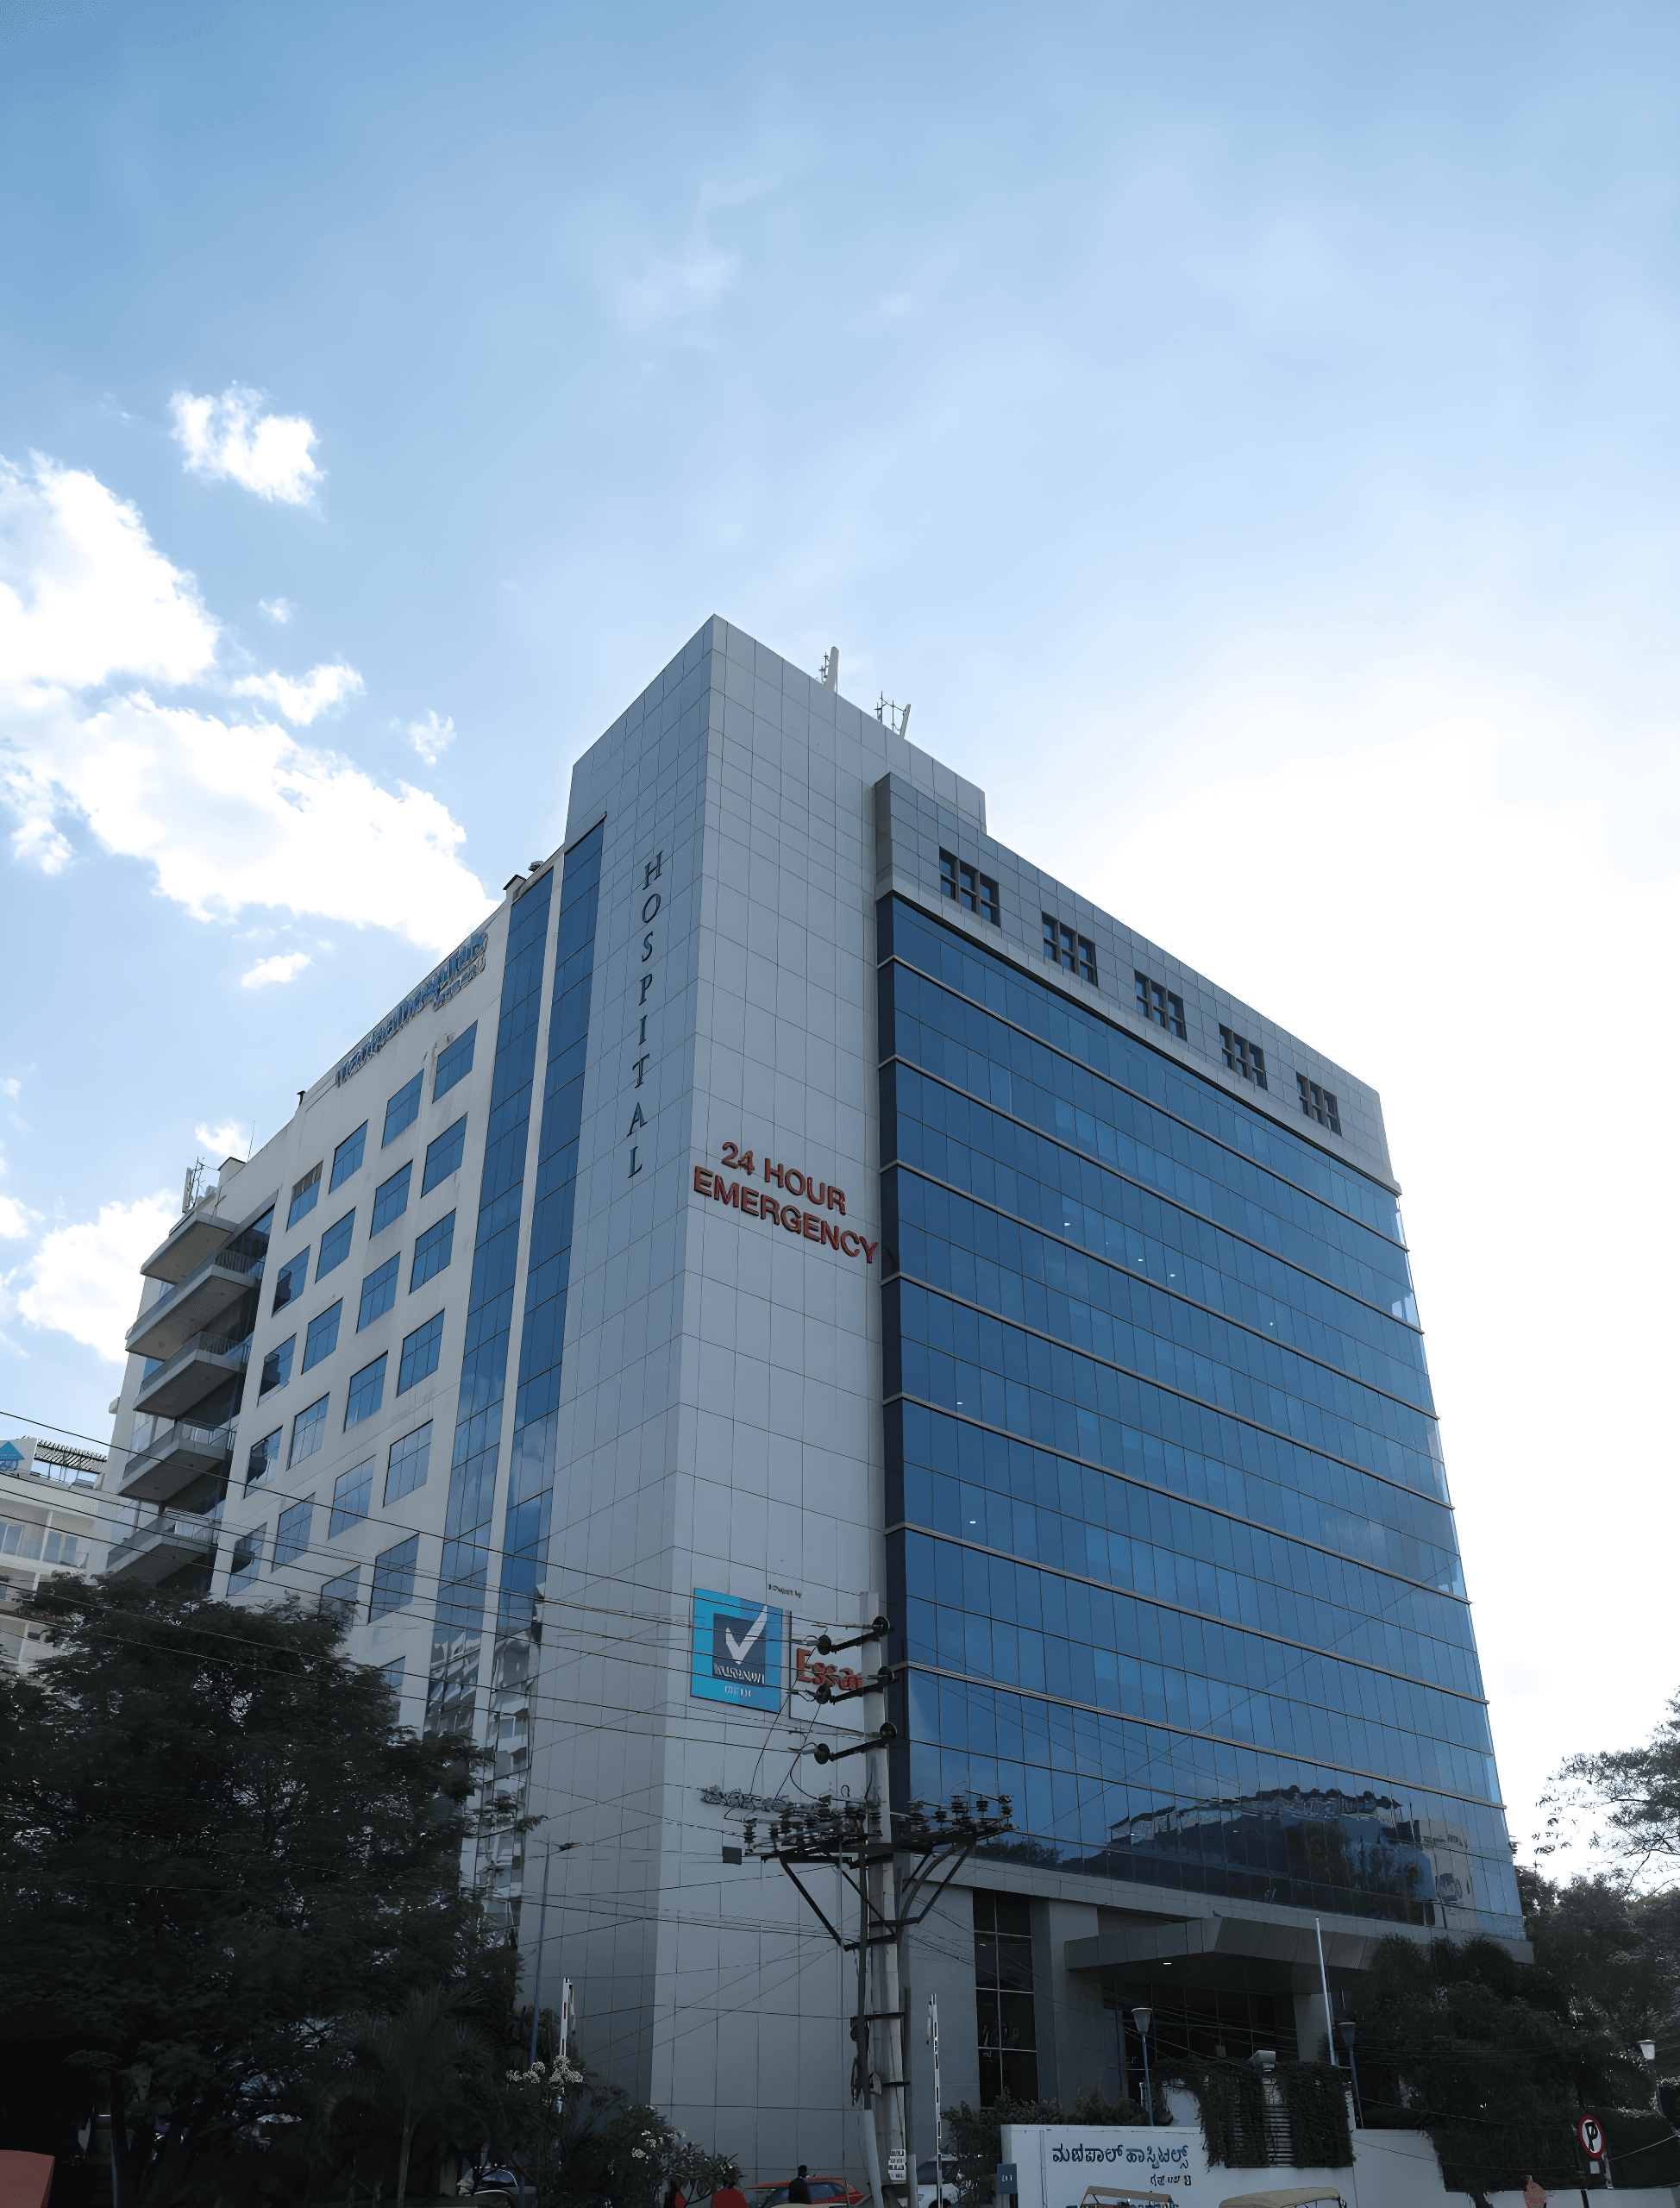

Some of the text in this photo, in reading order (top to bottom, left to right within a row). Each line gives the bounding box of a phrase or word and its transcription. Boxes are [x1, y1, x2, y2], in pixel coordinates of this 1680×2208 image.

[627, 850, 664, 1179] HOSPITAL
[693, 1165, 878, 1264] EMERGENCY
[721, 1141, 846, 1216] 24 HOUR
